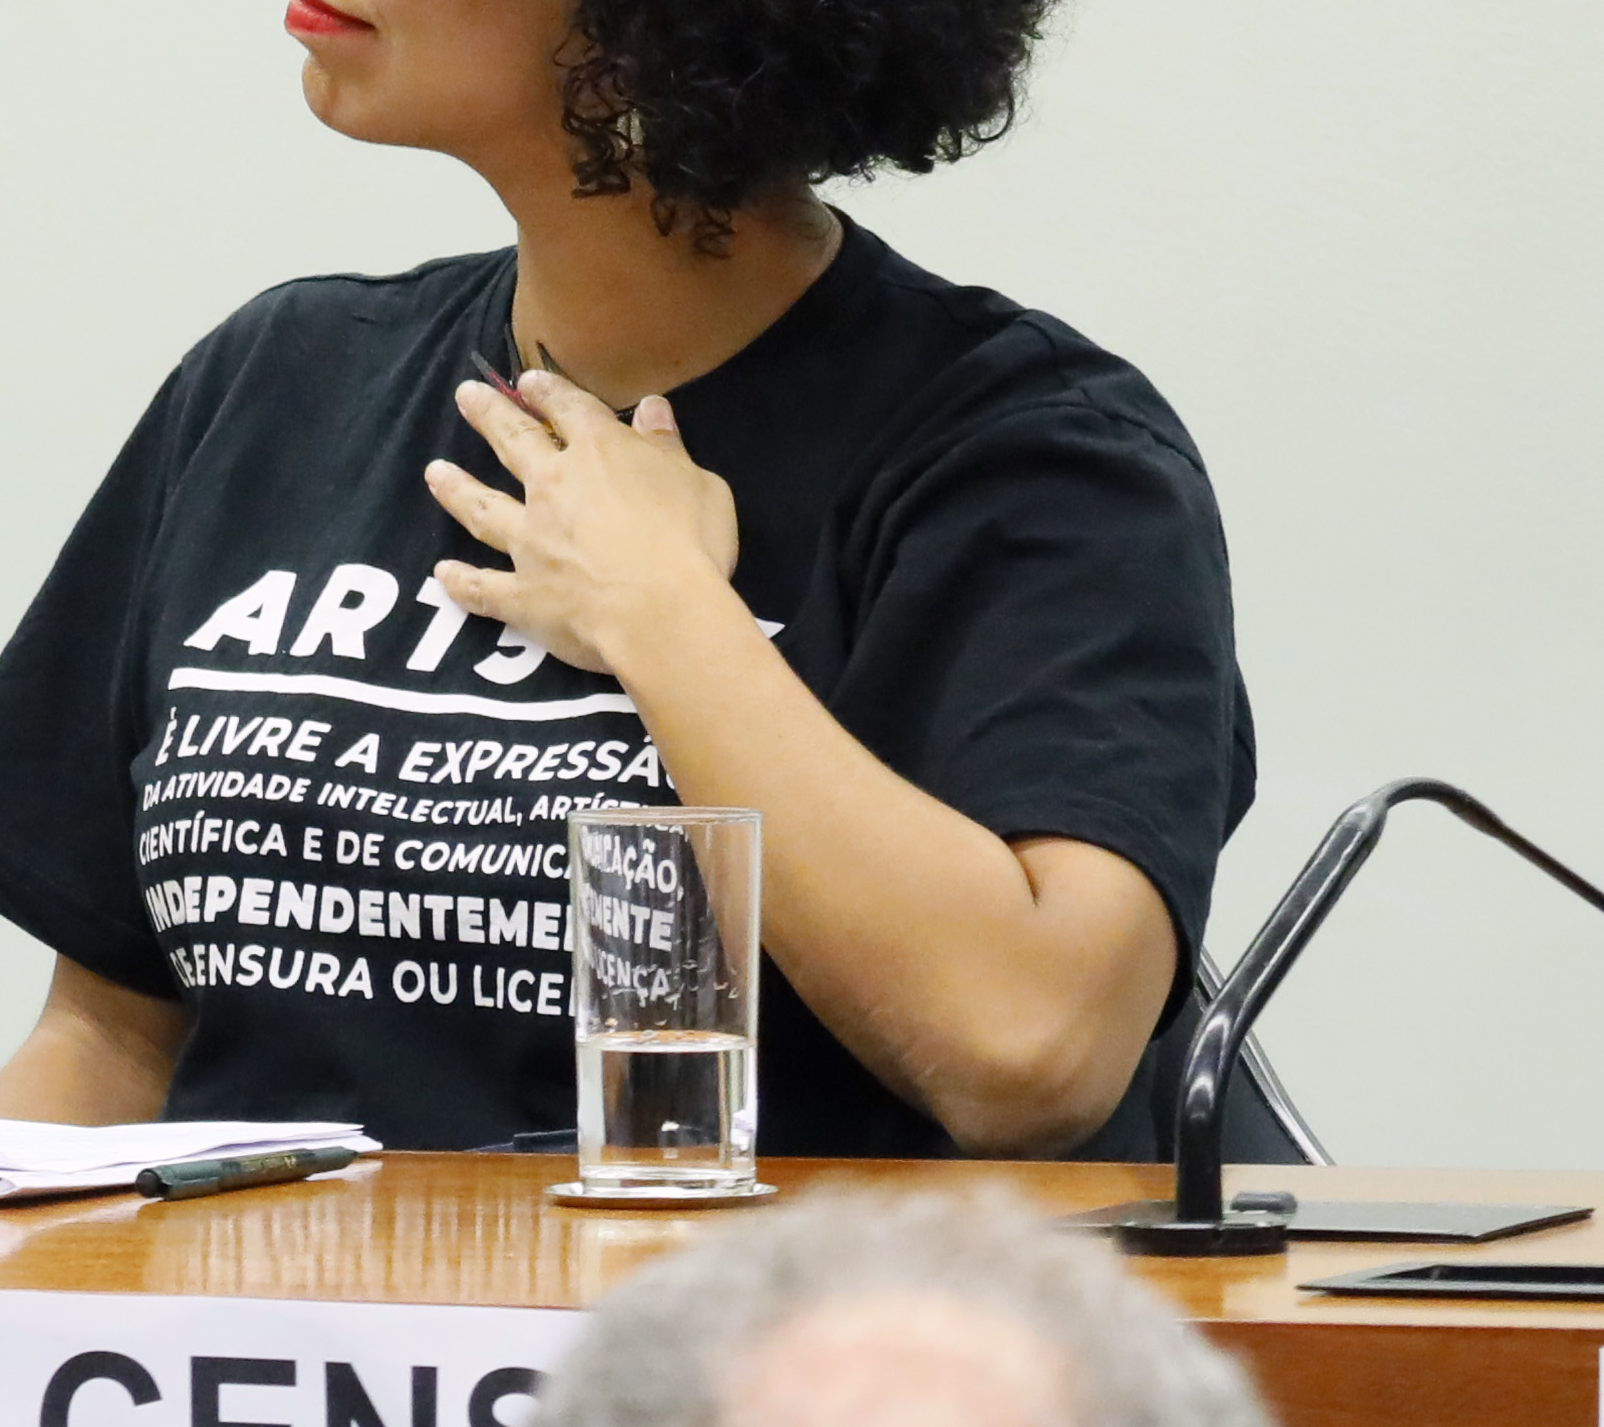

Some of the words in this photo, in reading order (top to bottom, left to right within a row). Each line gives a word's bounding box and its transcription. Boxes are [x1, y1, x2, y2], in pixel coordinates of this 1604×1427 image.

[177, 715, 332, 762] LIVRE
[335, 733, 380, 773] A
[398, 735, 676, 789] EXPRESSÃ
[161, 771, 311, 802] ATIVIDADE
[317, 782, 523, 826] INTELECTUAL,
[139, 810, 287, 865] CIENTÍFICA
[303, 827, 323, 861] E
[336, 830, 384, 866] DE
[393, 961, 457, 1004] OU
